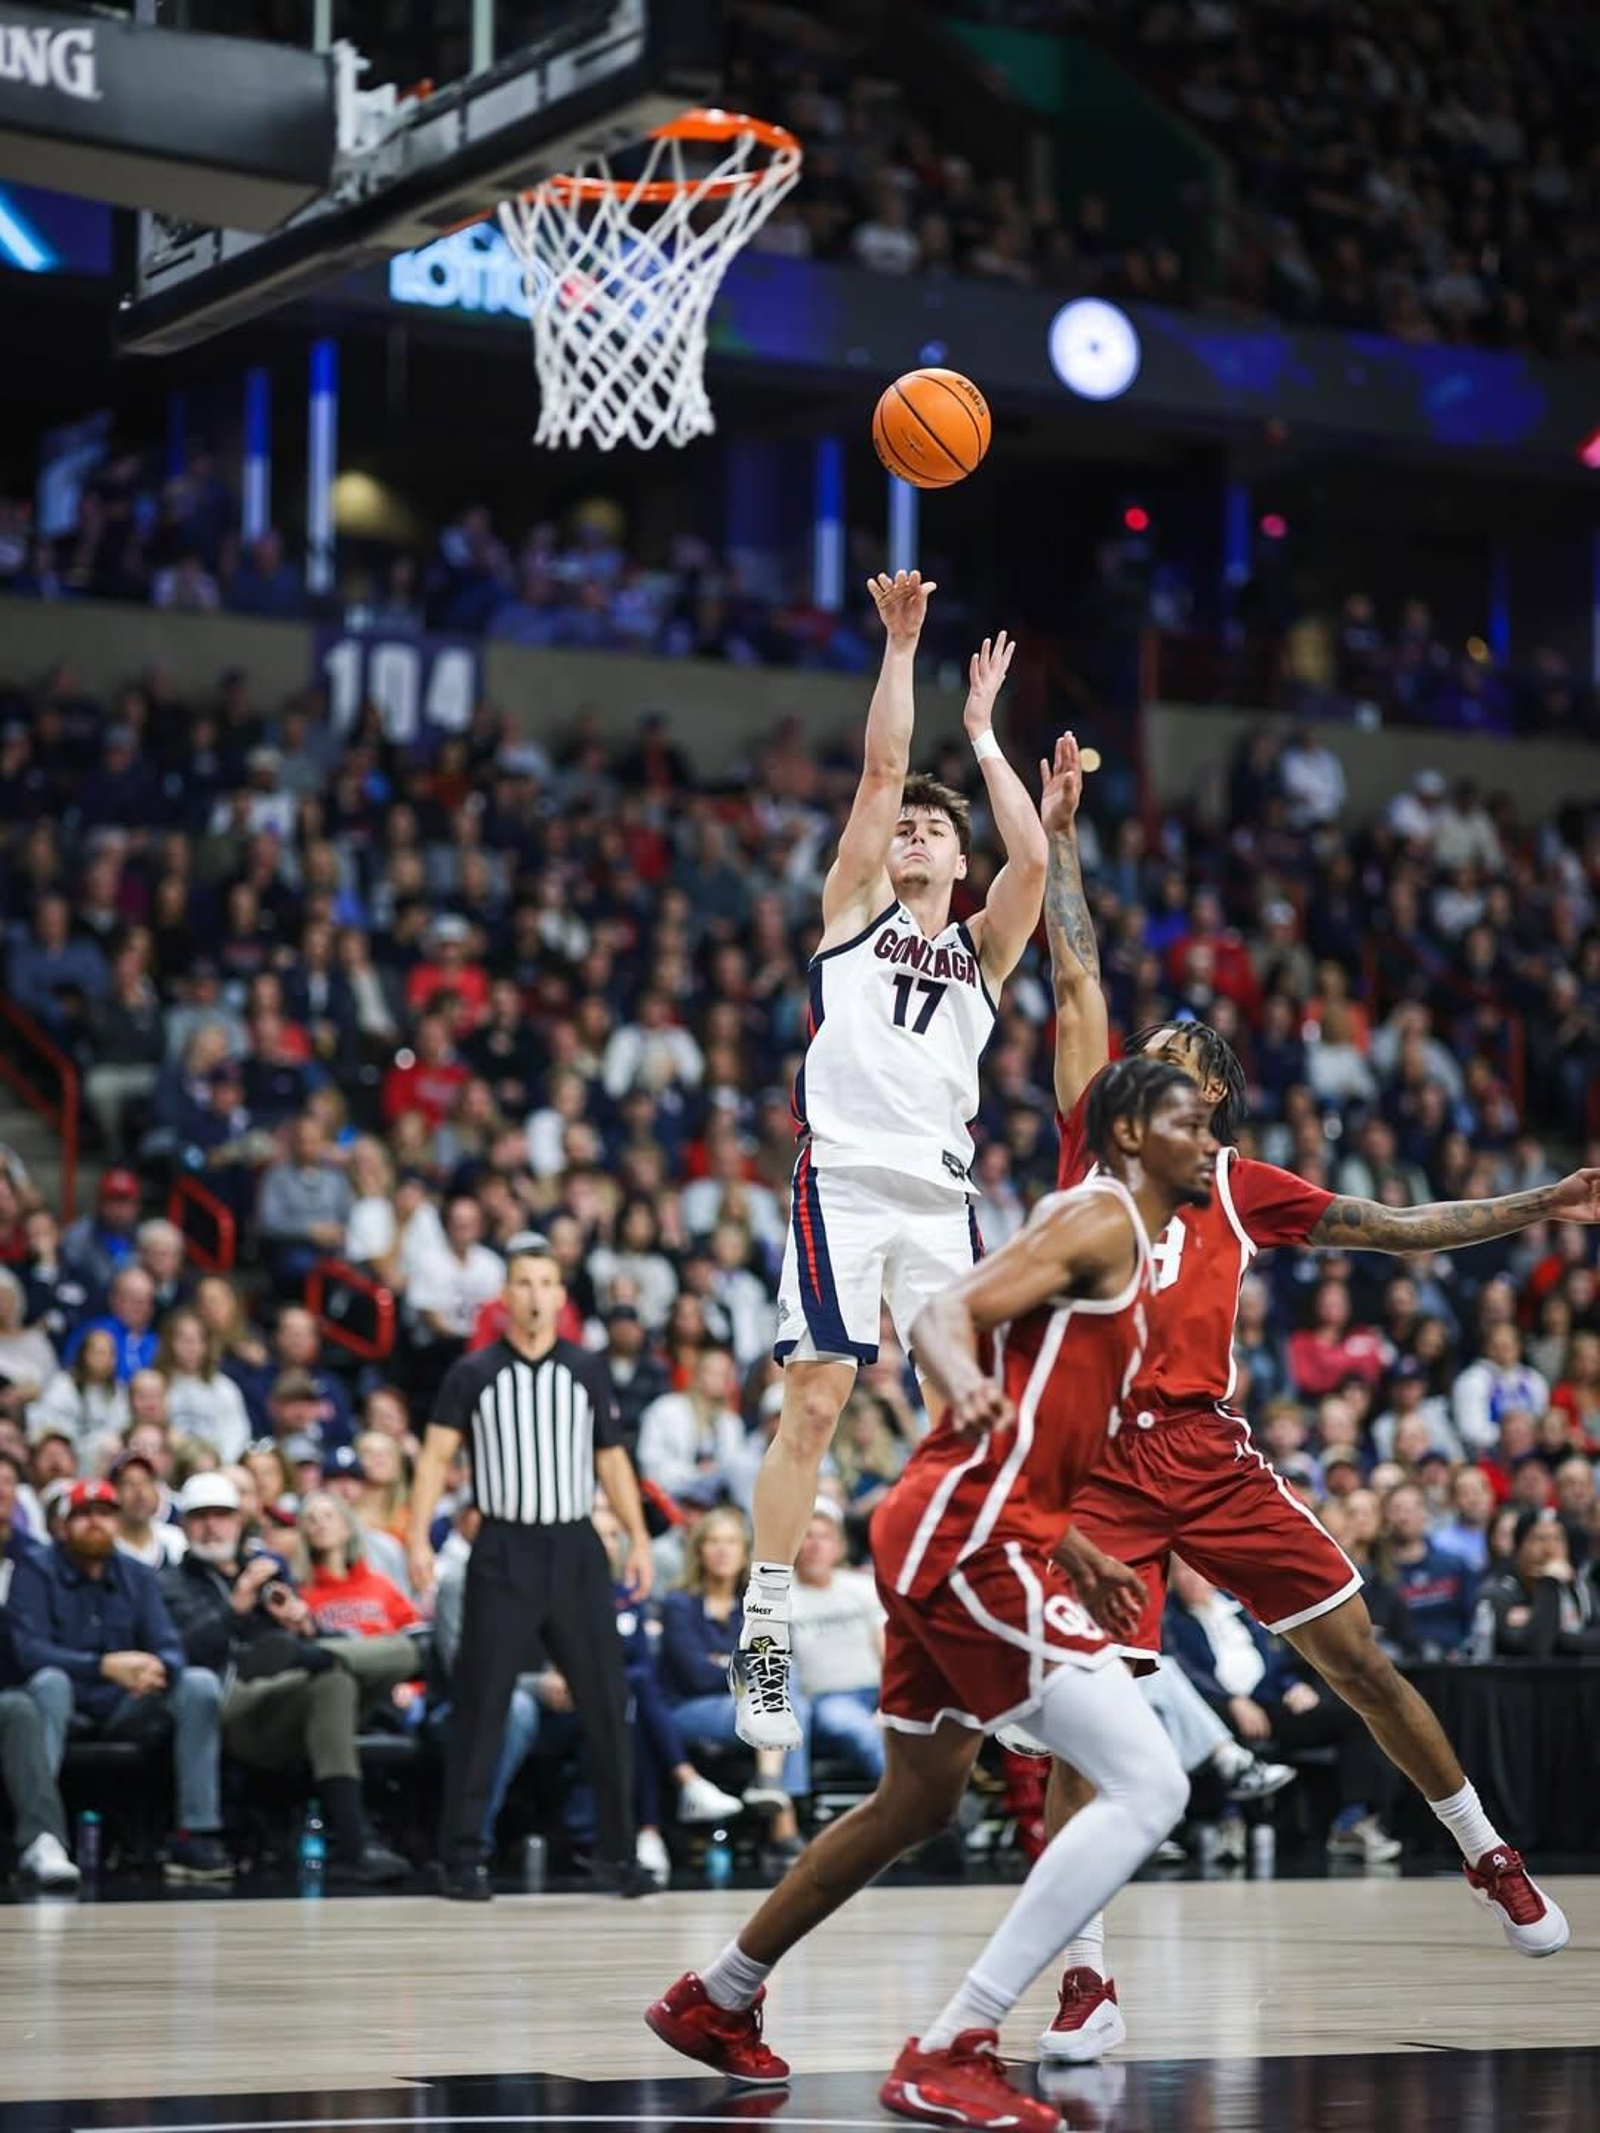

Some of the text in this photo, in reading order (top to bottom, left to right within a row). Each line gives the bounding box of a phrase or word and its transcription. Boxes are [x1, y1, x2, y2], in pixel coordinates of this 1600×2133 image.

[324, 640, 475, 743] 104
[873, 928, 976, 988] GONZAGA
[892, 973, 948, 1035] 17
